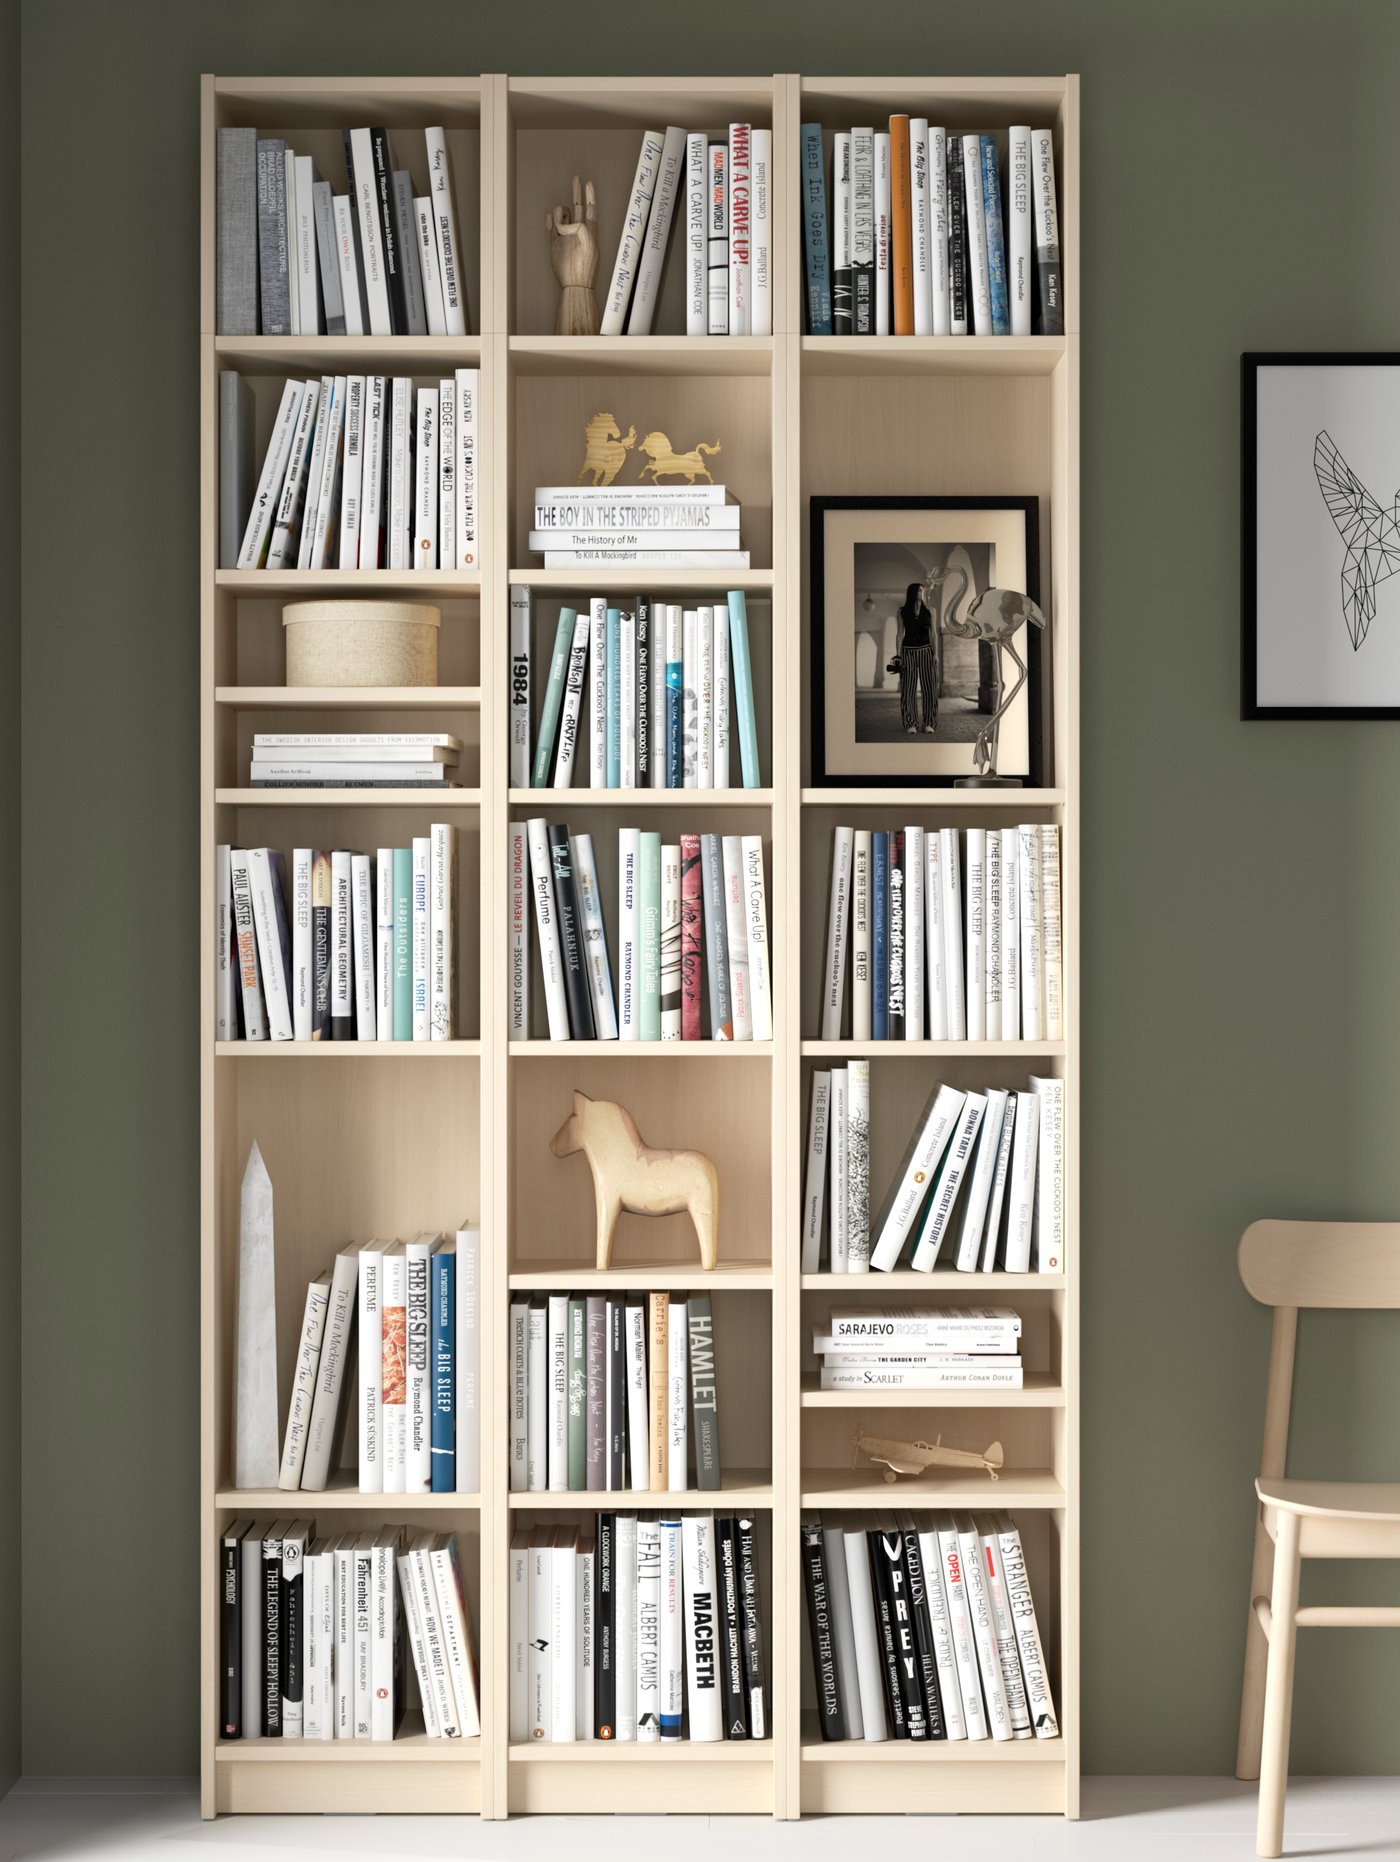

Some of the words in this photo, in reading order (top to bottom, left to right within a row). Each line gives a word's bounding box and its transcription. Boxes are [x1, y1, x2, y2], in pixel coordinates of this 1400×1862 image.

[691, 140, 702, 173] WHAT
[732, 126, 749, 169] WHAT
[807, 135, 821, 169] When
[854, 135, 872, 154] FEAR
[1015, 141, 1026, 160] THE
[1040, 139, 1050, 155] One
[667, 156, 678, 168] To
[1015, 163, 1026, 180] BIG
[1041, 157, 1051, 173] Flew
[259, 151, 267, 205] OCCUPATION
[663, 170, 674, 186] Kill
[691, 179, 702, 187] A
[732, 173, 749, 183] A
[808, 178, 823, 203] Ink
[854, 164, 872, 200] LOATHING
[1042, 175, 1051, 194] Over
[362, 183, 370, 201] CARL
[1015, 183, 1026, 213] SLEEP
[1043, 195, 1051, 207] the
[691, 192, 702, 229] CARVE
[732, 186, 749, 235] CARVE
[854, 202, 872, 210] IN
[364, 202, 375, 242] BENGTSSON
[651, 195, 670, 251] Mockingbird
[810, 211, 824, 246] Goes
[854, 212, 872, 227] LAS
[1044, 208, 1054, 242] Cuckoo's
[691, 234, 702, 252] UP!
[732, 239, 749, 265] UP!
[854, 230, 872, 253] VEGAS
[1046, 243, 1056, 260] Nest
[369, 244, 379, 282] PORTRAITS
[811, 254, 826, 280] Dry
[694, 257, 702, 297] JONATHAN
[1048, 274, 1057, 287] Ken
[694, 300, 702, 315] COE
[1047, 288, 1059, 307] Kesey
[350, 382, 360, 408] PROPERTY
[373, 376, 381, 398] LAST
[349, 409, 359, 431] SUCCESS
[372, 401, 381, 420] TICK
[349, 432, 358, 456] FORMULA
[537, 507, 556, 526] THE
[560, 507, 580, 526] BOY
[582, 507, 594, 526] IN
[597, 507, 616, 526] THE
[619, 507, 660, 526] STRIPED
[663, 507, 711, 527] PYJAMAS
[571, 535, 586, 544] The
[587, 535, 615, 546] History
[617, 535, 626, 544] of
[627, 535, 638, 544] Mr
[596, 604, 604, 620] One
[639, 605, 648, 620] Ken
[596, 623, 604, 639] Flew
[637, 621, 648, 642] Kesey
[596, 642, 604, 661] Over
[639, 648, 648, 664] ONE
[512, 653, 528, 706] 1984
[596, 663, 604, 678] The
[639, 665, 648, 684] FLEW
[596, 681, 605, 713] Cuckoo's
[639, 685, 648, 703] OVER
[521, 709, 528, 718] by
[596, 716, 604, 733] Nest
[639, 719, 648, 754] CUCKOO'S
[639, 755, 647, 772] NEST
[551, 841, 571, 879] Tell-All
[748, 849, 760, 877] What
[971, 862, 982, 884] THE
[233, 868, 248, 891] PAUL
[750, 880, 761, 888] A
[415, 874, 426, 913] EUROPE
[537, 876, 551, 924] Perfume
[971, 886, 982, 904] BIG
[235, 893, 251, 926] AUSTER
[316, 908, 327, 926] THE
[338, 878, 347, 950] ARCHITECTURAL
[751, 892, 763, 923] Carve
[397, 897, 408, 954] Outsiders
[645, 907, 658, 945] Grimm's
[750, 925, 765, 943] Up!
[971, 906, 982, 936] SLEEP
[238, 931, 255, 964] SUNSET
[563, 906, 580, 971] PALAHNIUK
[316, 927, 327, 986] GENTLEMAN'S
[397, 958, 407, 978] The
[514, 948, 523, 988] GOUYSSE
[644, 947, 658, 970] Fairy
[242, 965, 257, 988] PARK
[338, 952, 348, 1001] GEOMETRY
[645, 970, 658, 993] Tales
[316, 988, 327, 1012] CLUB
[415, 978, 426, 1013] ISRAEL
[514, 990, 523, 1029] VINCENT
[963, 1109, 979, 1135] DONNA
[956, 1136, 971, 1160] TARTT
[947, 1170, 960, 1183] THE
[938, 1184, 956, 1212] SECRET
[928, 1212, 946, 1246] HISTORY
[408, 1258, 427, 1291] THE
[366, 1265, 376, 1313] PERFUME
[408, 1292, 427, 1321] BIG
[655, 1295, 666, 1345] Carrie's
[838, 1323, 894, 1335] SARAJEVO
[408, 1321, 427, 1371] SLEEP
[555, 1332, 564, 1349] THE
[555, 1351, 564, 1367] BIG
[689, 1315, 717, 1412] HAMLET
[555, 1369, 565, 1393] SLEEP
[412, 1377, 423, 1414] Raymond
[413, 1415, 423, 1452] Chandler
[701, 1421, 712, 1470] SHAKESPEARE
[601, 1531, 610, 1567] CLOCKWORK
[905, 1535, 921, 1576] CAGED
[966, 1544, 978, 1566] THE
[637, 1542, 661, 1583] FALL
[810, 1556, 824, 1580] THE
[266, 1568, 278, 1589] THE
[357, 1558, 369, 1613] Fahrenheit
[601, 1568, 610, 1592] ORANGE
[910, 1577, 924, 1605] LION
[969, 1567, 983, 1596] OPEN
[1001, 1546, 1033, 1619] STRANGER
[812, 1582, 827, 1610] WAR
[266, 1591, 278, 1632] LEGEND
[358, 1615, 368, 1633] 451
[425, 1616, 436, 1633] HOW
[640, 1602, 657, 1646] ALBERT
[816, 1612, 829, 1630] OF
[975, 1598, 989, 1627] HAND
[266, 1632, 278, 1646] OF
[428, 1635, 438, 1647] WE
[693, 1592, 715, 1689] MACBETH
[817, 1632, 832, 1659] THE
[1020, 1630, 1040, 1666] ALBERT
[266, 1647, 278, 1680] SLEEPY
[429, 1648, 442, 1668] MADE
[640, 1651, 657, 1690] CAMUS
[921, 1654, 934, 1683] HELEN
[821, 1661, 838, 1715] WORLDS
[1027, 1669, 1048, 1703] CAMUS
[266, 1682, 278, 1727] HOLLOW
[926, 1685, 939, 1727] WALTERS
